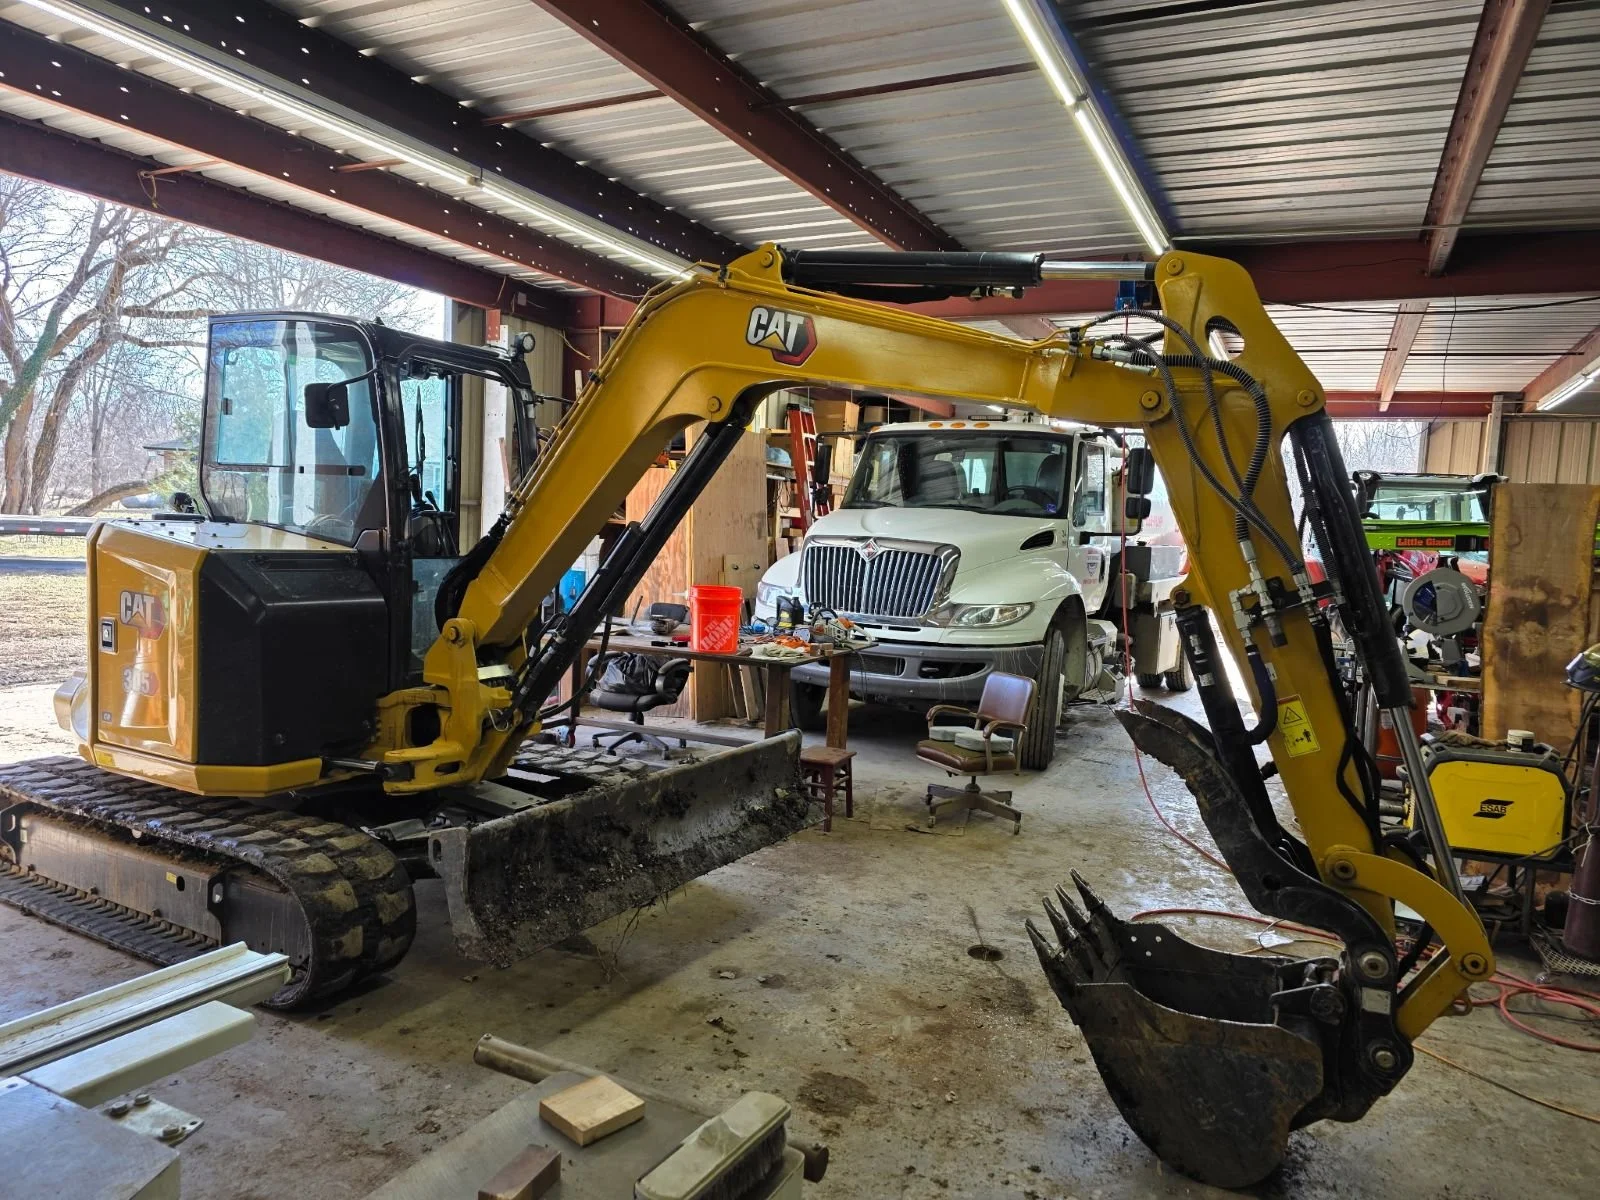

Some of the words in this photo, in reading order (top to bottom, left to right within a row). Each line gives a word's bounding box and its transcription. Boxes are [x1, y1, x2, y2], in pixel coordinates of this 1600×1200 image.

[747, 307, 804, 352] CAT
[1397, 537, 1424, 546] Little
[1426, 537, 1452, 546] Giant
[120, 591, 155, 628] CAT
[700, 616, 734, 650] HOME
[123, 667, 150, 693] 305
[1480, 804, 1507, 814] ESAB
